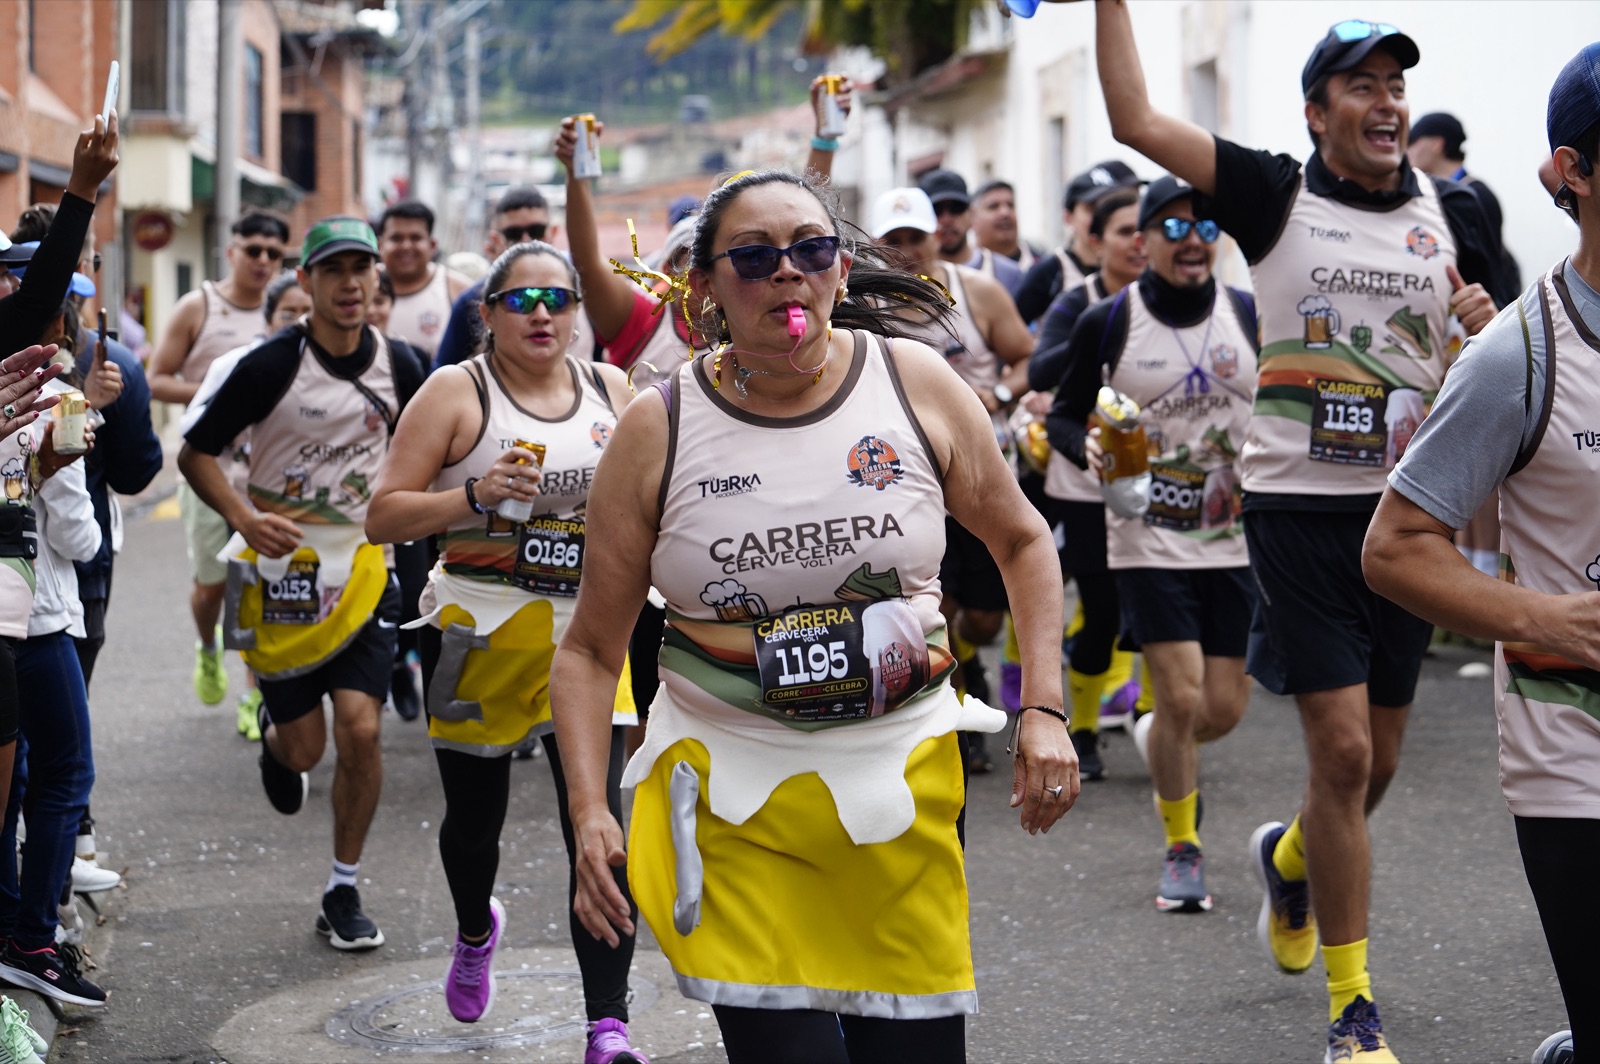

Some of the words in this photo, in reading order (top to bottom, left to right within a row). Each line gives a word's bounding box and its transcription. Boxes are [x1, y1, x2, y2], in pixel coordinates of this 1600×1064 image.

[1311, 267, 1435, 293] CARRERA
[1317, 381, 1384, 398] CARRERA
[1323, 403, 1373, 433] 1133
[709, 513, 904, 563] CARRERA
[525, 538, 580, 568] 0186
[722, 541, 857, 575] CERVECERA
[799, 559, 826, 569] VOL
[268, 579, 311, 600] 0152
[757, 606, 854, 637] CARRERA
[764, 625, 829, 643] CERVECERA
[776, 640, 849, 686] 1195
[881, 659, 911, 676] CARRERA
